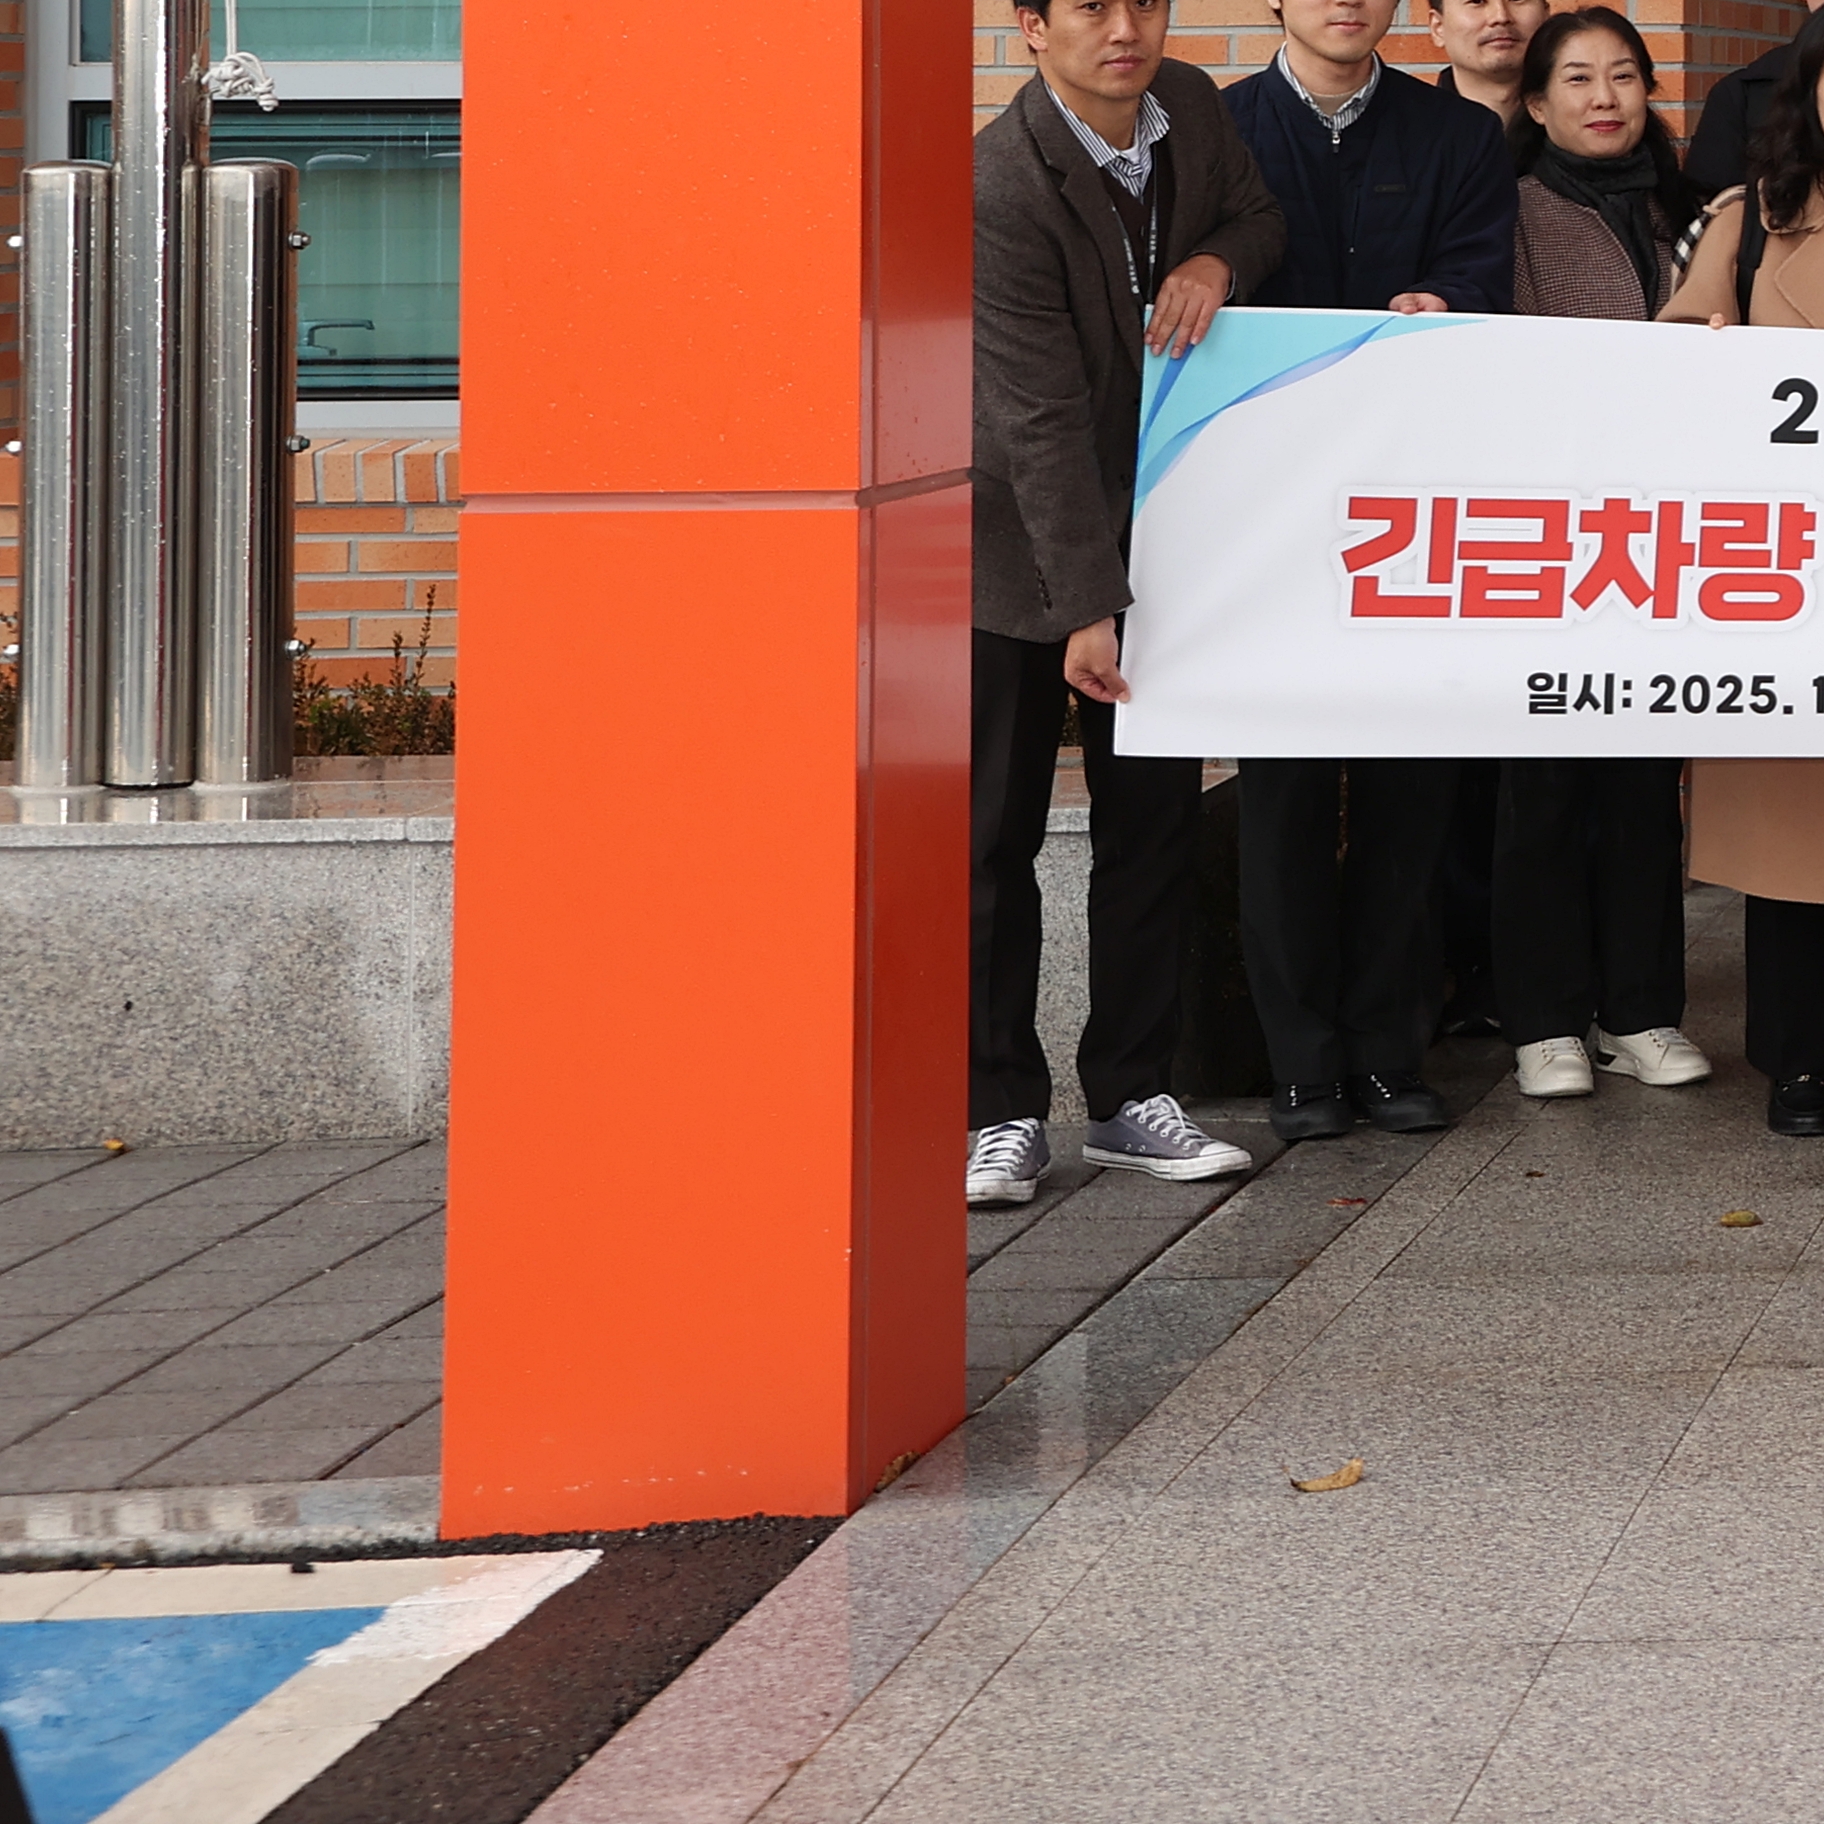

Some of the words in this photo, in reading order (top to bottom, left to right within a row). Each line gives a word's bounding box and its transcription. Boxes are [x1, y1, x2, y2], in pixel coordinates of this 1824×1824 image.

[1340, 496, 1816, 622] 긴급차량
[1527, 672, 1632, 715] 일시:
[1649, 674, 1794, 715] 2025.
